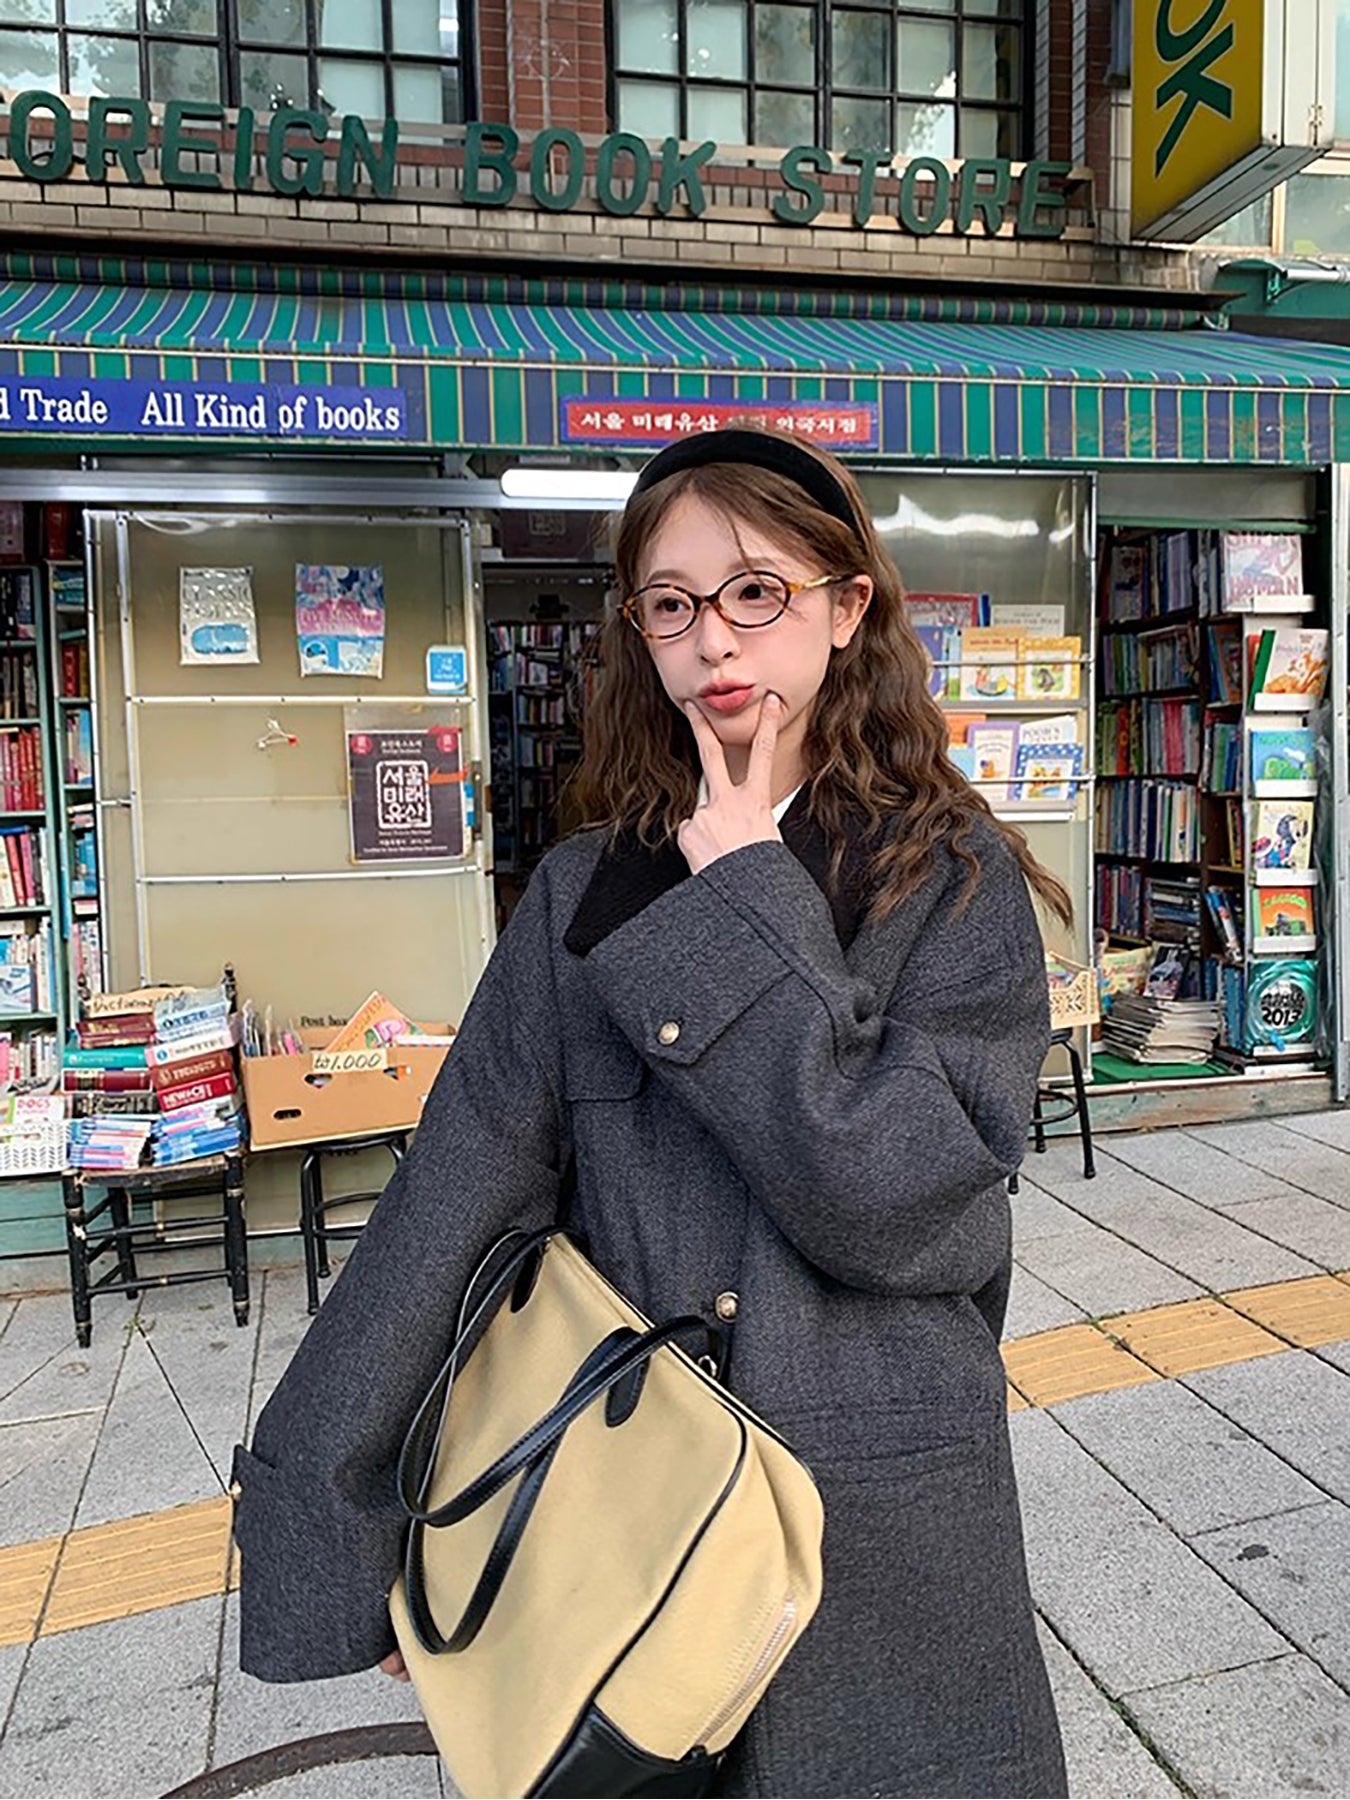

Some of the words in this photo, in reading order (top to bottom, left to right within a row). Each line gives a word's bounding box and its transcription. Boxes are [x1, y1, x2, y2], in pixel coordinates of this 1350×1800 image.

[0, 89, 399, 198] OREIGN
[462, 122, 717, 218] BOOK
[772, 145, 1074, 238] STORE
[20, 388, 109, 425] Trade
[141, 391, 185, 427] All
[195, 392, 267, 429] Kind
[278, 394, 307, 433] of
[316, 396, 401, 432] books
[580, 411, 625, 431] 서울
[631, 412, 720, 432] 미래유산
[382, 765, 424, 786] 서울
[382, 786, 424, 803] 미래
[384, 802, 425, 823] 유산
[1261, 1006, 1302, 1026] 2013
